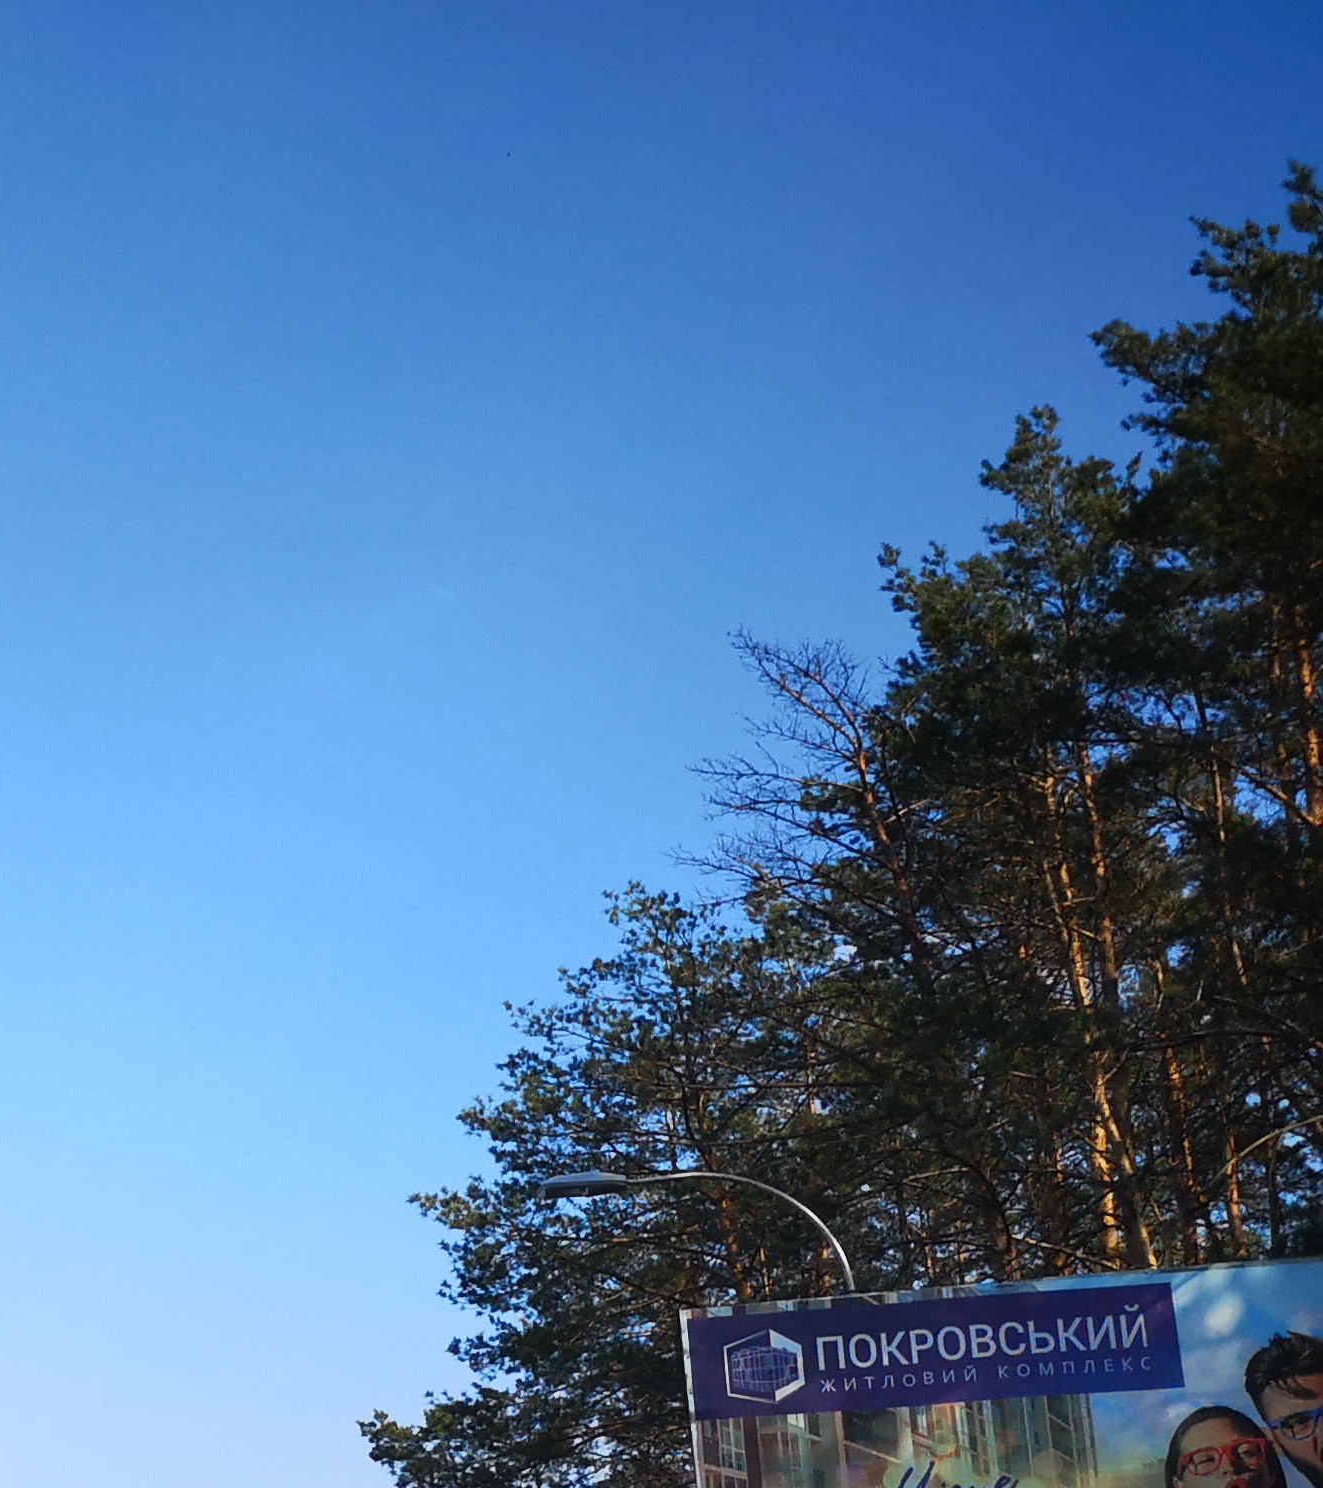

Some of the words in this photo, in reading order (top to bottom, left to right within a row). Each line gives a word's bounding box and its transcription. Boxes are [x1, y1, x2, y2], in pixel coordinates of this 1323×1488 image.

[815, 1303, 1149, 1371] ПОКРОВСЬКИЙ
[820, 1365, 978, 1393] ЖИТЛОВИЙ
[998, 1356, 1152, 1379] КОМПЛЕКС
